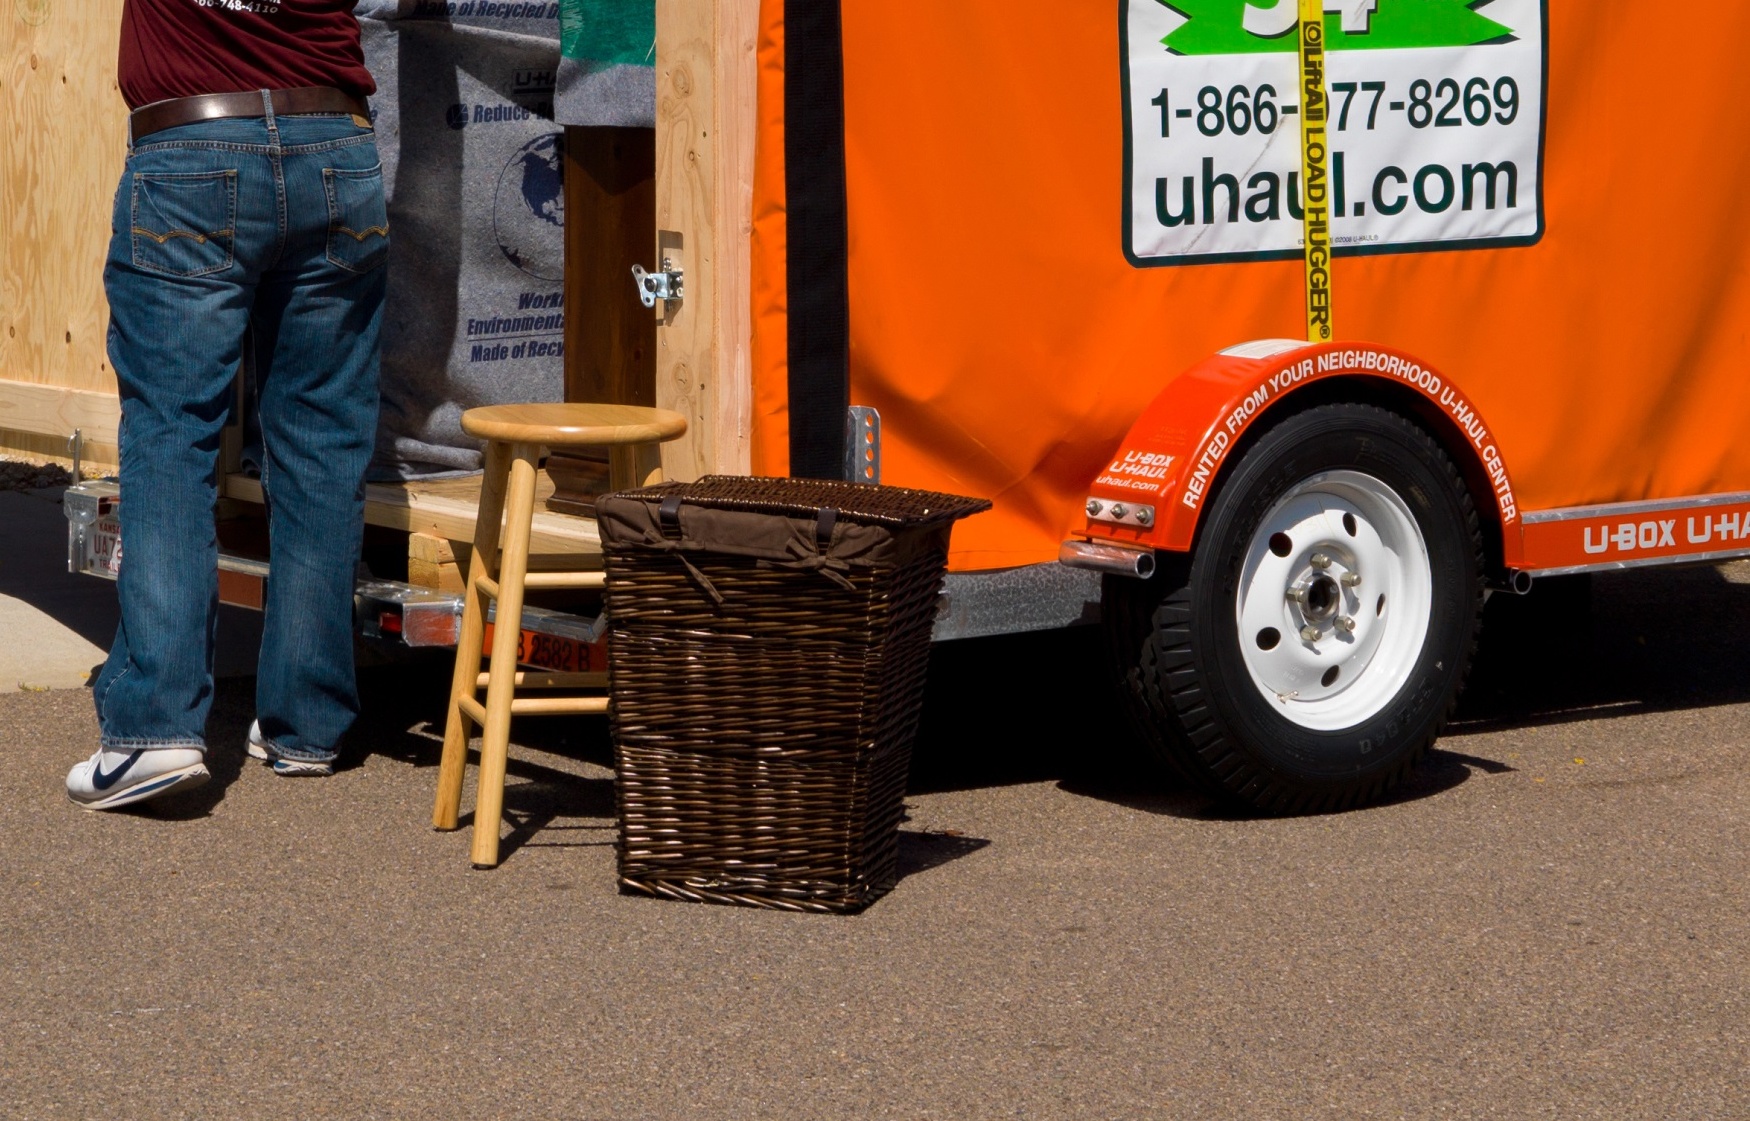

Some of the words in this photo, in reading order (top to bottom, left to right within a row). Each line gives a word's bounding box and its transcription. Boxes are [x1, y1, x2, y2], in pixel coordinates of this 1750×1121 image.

[476, 0, 547, 19] Recycled
[515, 70, 555, 86] U-H
[1150, 75, 1520, 138] 1-866-77-8269
[1306, 126, 1327, 203] LOAD
[471, 344, 509, 363] Made
[511, 342, 527, 359] of
[1182, 430, 1229, 509] RENTED
[1225, 384, 1270, 435] FROM
[1268, 359, 1314, 393] YOUR
[1317, 350, 1442, 395] NEIGHBORHOOD
[1482, 445, 1516, 524] CENTER
[1124, 450, 1175, 468] U-BOX
[1109, 461, 1168, 480] U-HAUL
[1096, 475, 1160, 492] uhaul.com
[1584, 519, 1676, 554] U-BOX
[530, 634, 572, 671] 2582
[578, 643, 591, 672] B
